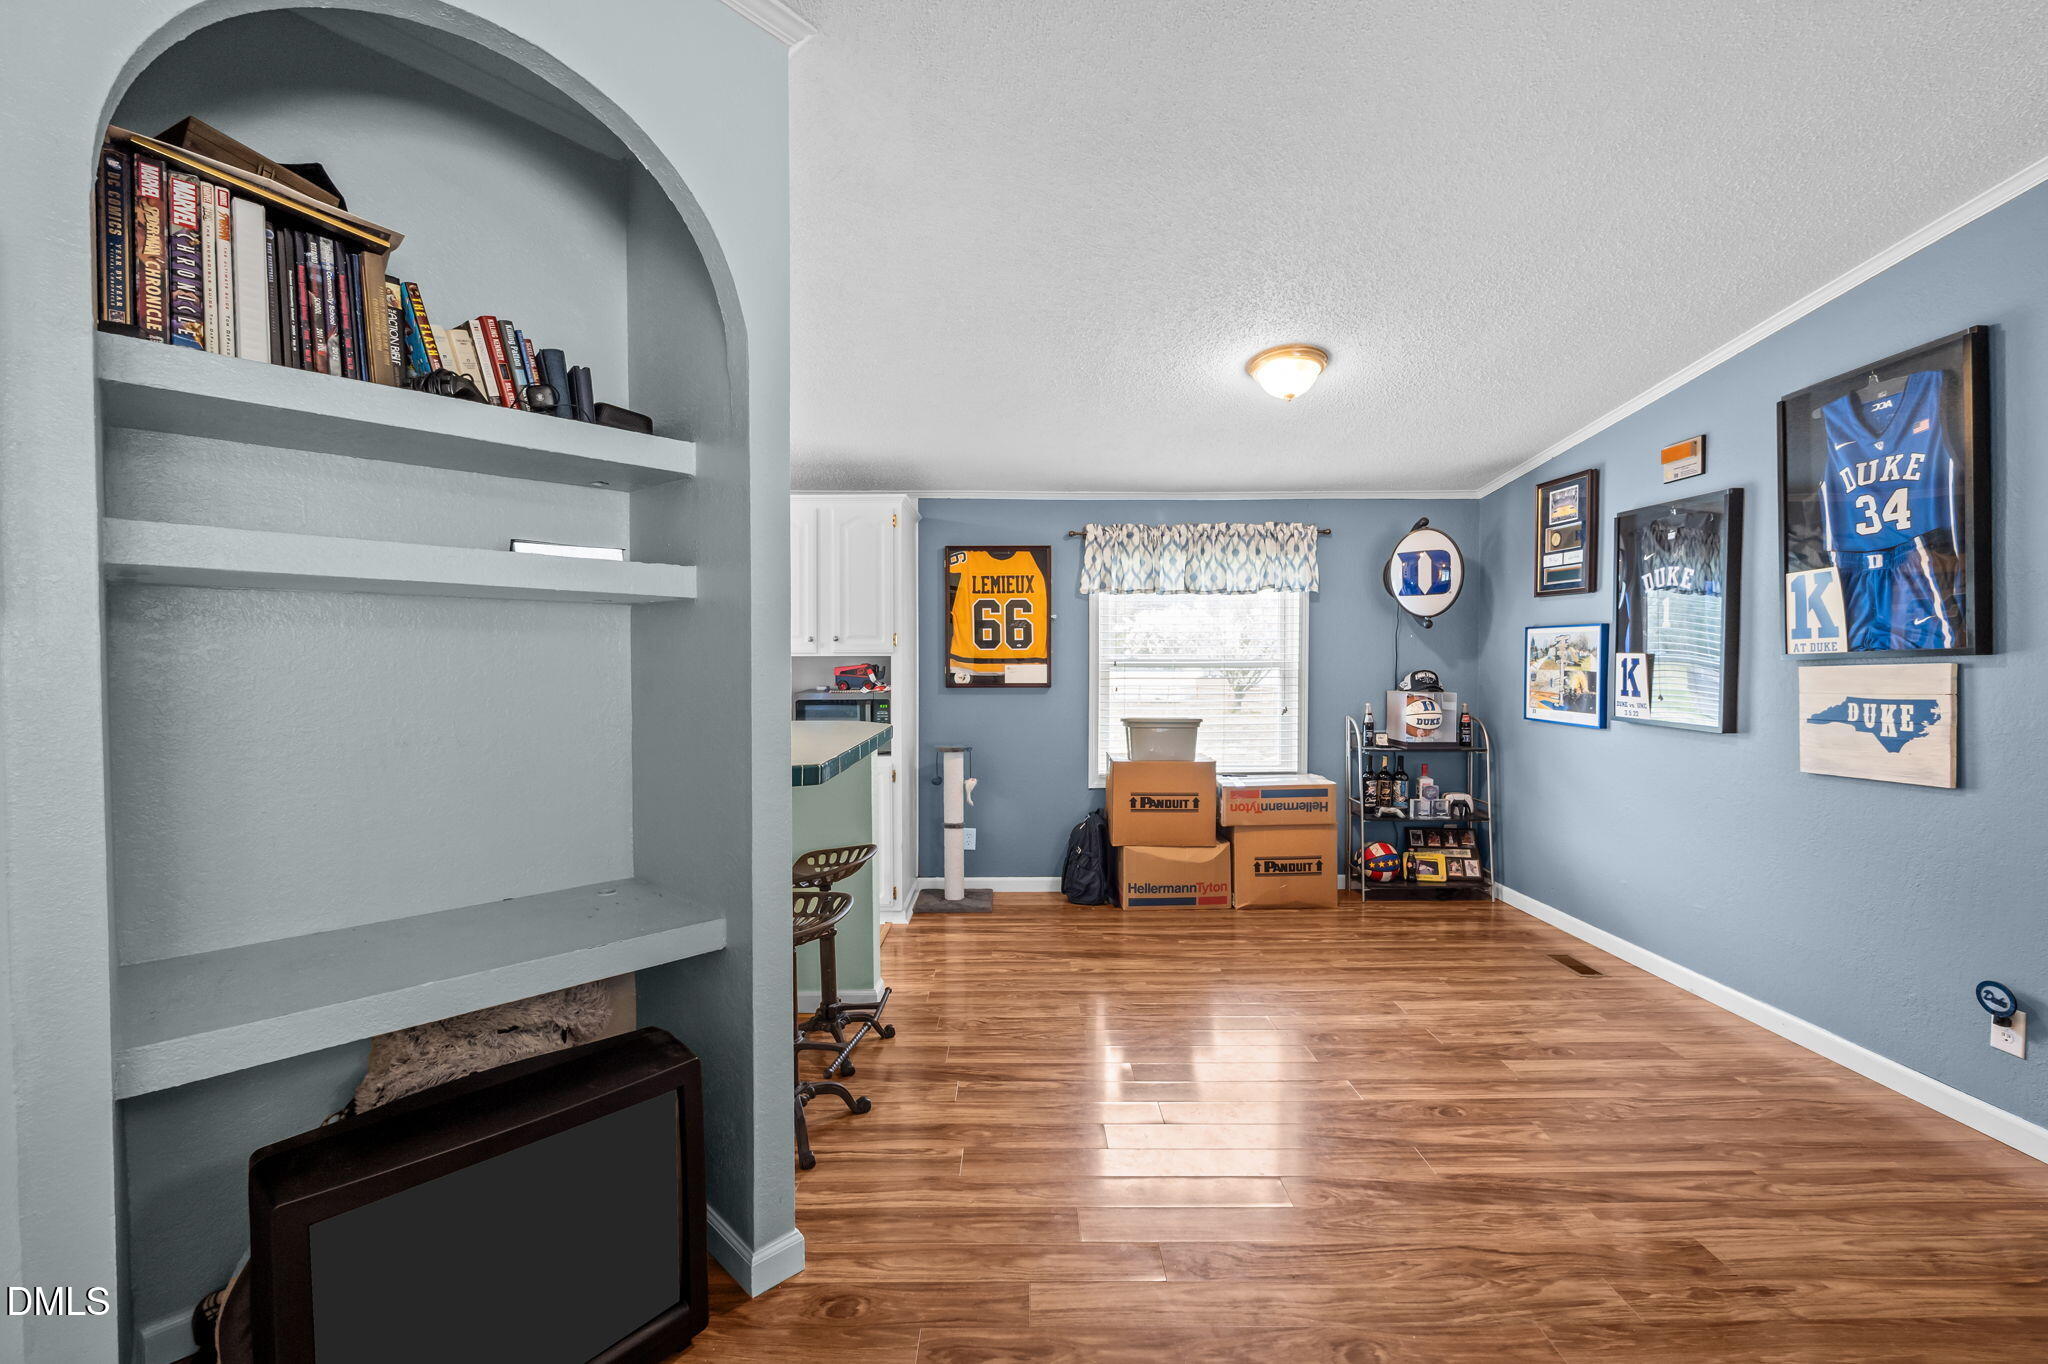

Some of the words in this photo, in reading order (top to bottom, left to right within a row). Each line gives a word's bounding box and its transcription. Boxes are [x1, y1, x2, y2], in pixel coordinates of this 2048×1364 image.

[107, 171, 121, 187] DC
[140, 162, 160, 198] MARVEL
[107, 190, 122, 236] COMICS
[172, 178, 197, 228] MARVEL
[144, 260, 163, 332] CHRONICLE
[176, 233, 197, 337] CHRONICLE
[326, 271, 334, 305] Community
[328, 305, 337, 325] School
[388, 313, 400, 346] ACTION
[411, 298, 427, 317] THE
[420, 324, 440, 356] FLASH
[487, 319, 499, 339] KILLING
[493, 339, 505, 361] KENNEDY
[505, 324, 516, 348] Killing
[511, 345, 522, 367] Patton
[1839, 452, 1925, 495] DUKE
[1855, 487, 1912, 536] 34
[972, 575, 1035, 594] LEMIEUX
[1641, 566, 1694, 593] DUKE
[972, 597, 1034, 650] 66
[1793, 643, 1807, 652] AT
[1810, 641, 1838, 652] DUKE
[1416, 717, 1441, 726] DUKE
[1847, 702, 1915, 738] DUKE
[1140, 796, 1190, 809] PANDUIT
[1230, 800, 1329, 814] HellermannTyton
[1263, 860, 1313, 873] PANDUIT
[1128, 882, 1228, 897] HellermannTyton
